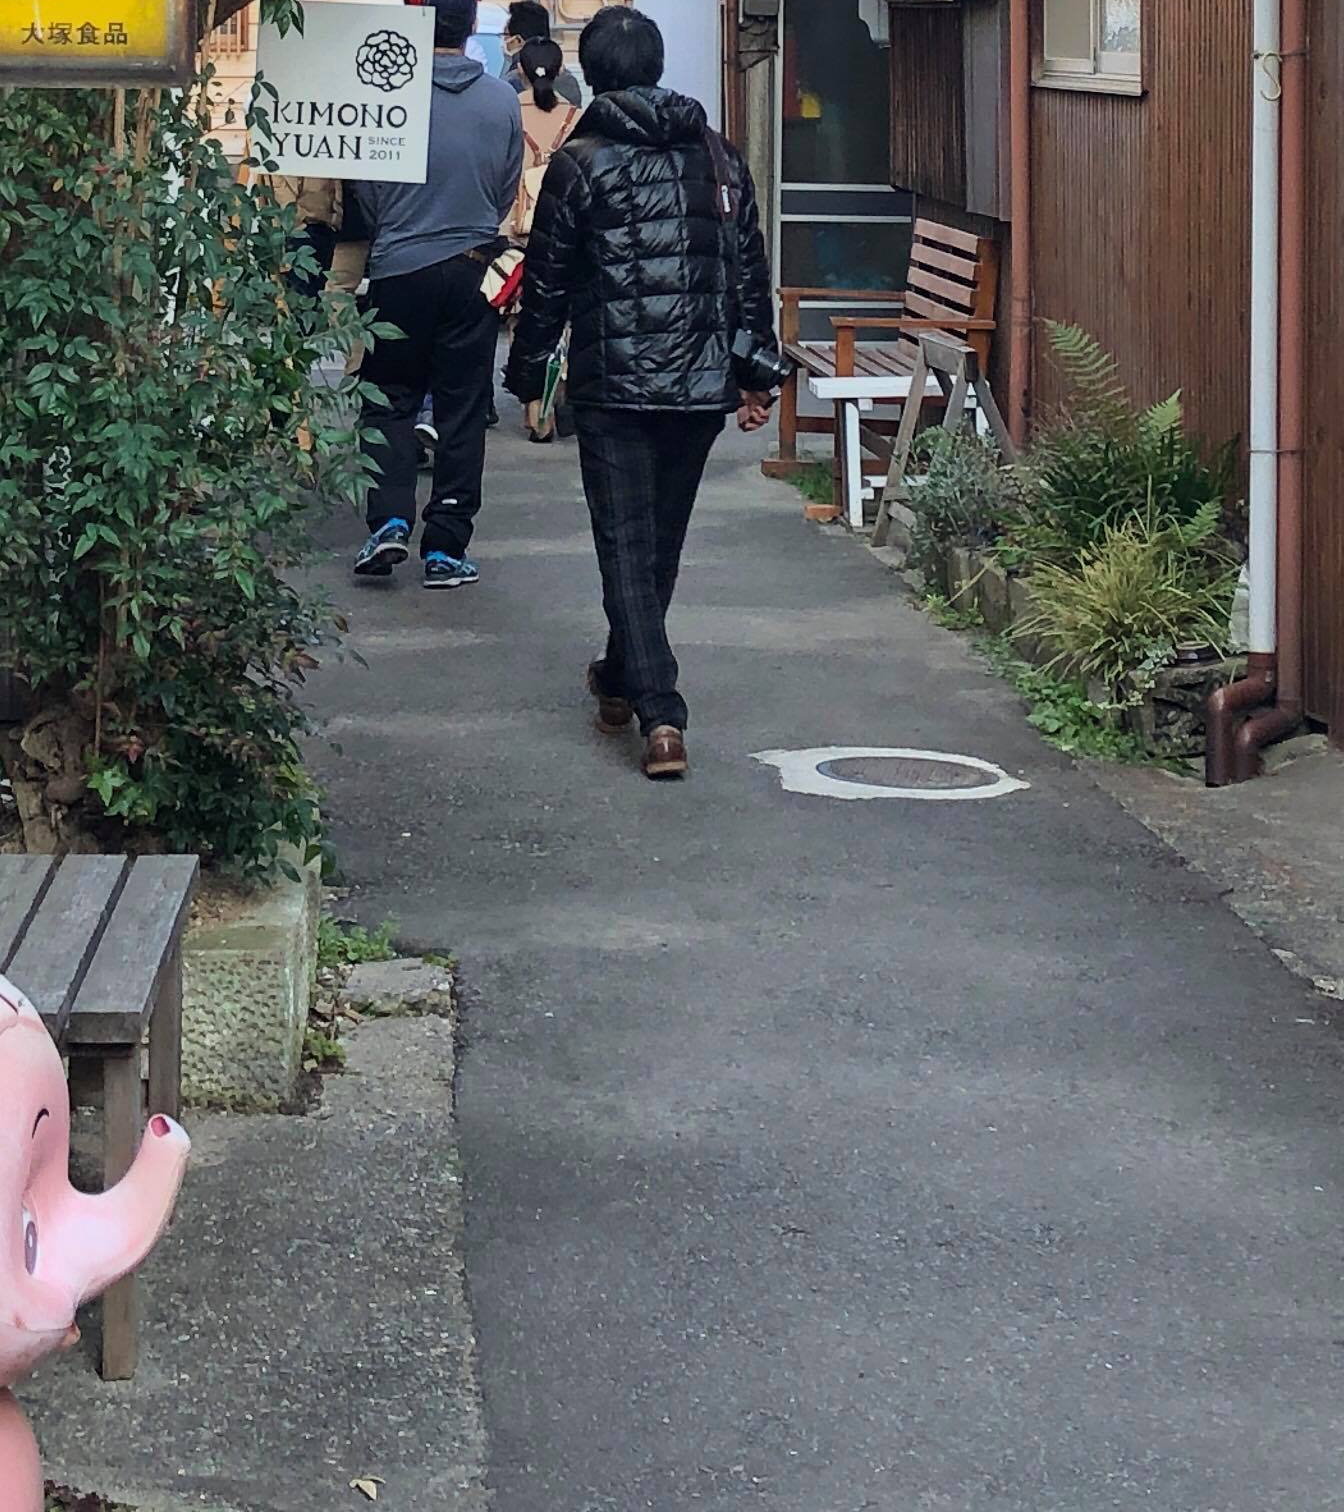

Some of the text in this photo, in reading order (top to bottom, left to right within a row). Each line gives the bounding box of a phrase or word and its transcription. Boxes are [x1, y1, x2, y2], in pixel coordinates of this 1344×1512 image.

[21, 22, 128, 45] 大塚食品
[272, 100, 408, 129] KIMONO
[271, 131, 362, 161] YUAN
[368, 135, 407, 147] SINCE
[368, 149, 402, 161] 2011
